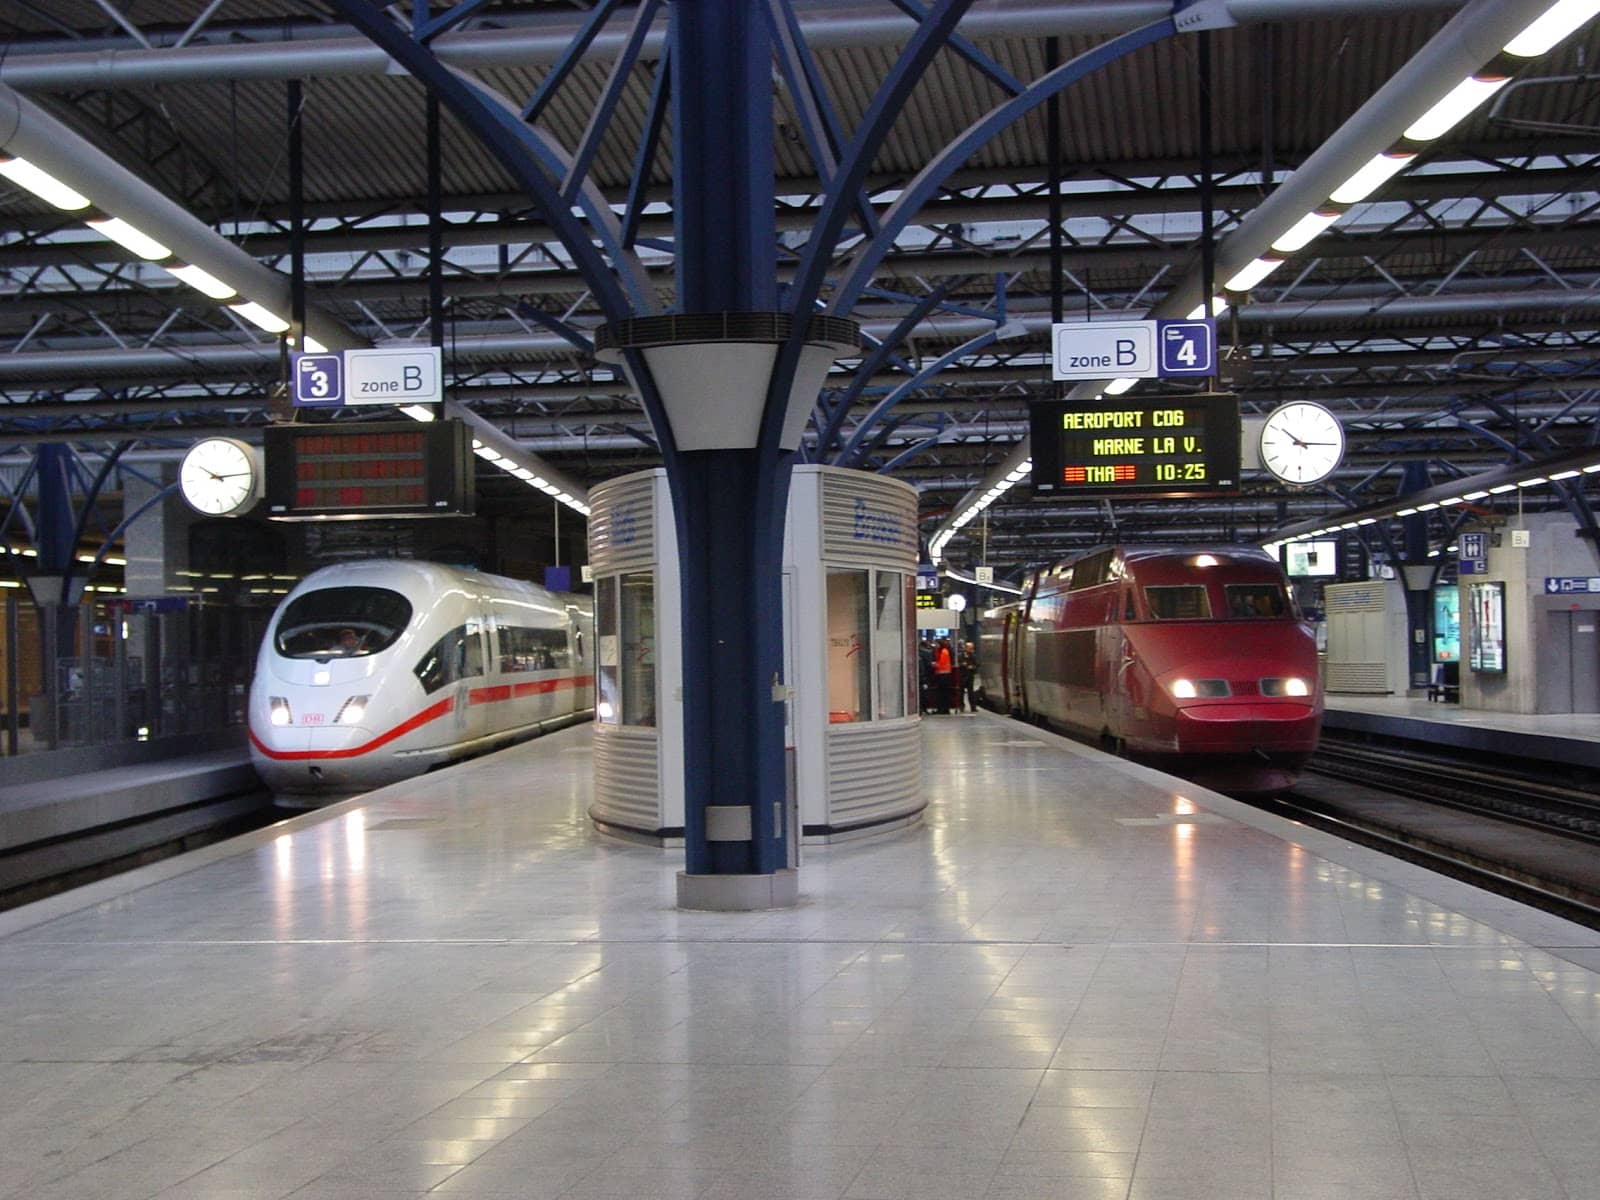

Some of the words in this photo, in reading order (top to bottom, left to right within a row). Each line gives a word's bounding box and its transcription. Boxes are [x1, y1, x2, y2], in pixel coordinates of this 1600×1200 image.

[1070, 355, 1111, 368] zone
[1116, 340, 1137, 366] B
[1177, 340, 1197, 366] 4
[310, 371, 329, 397] 3
[360, 381, 399, 392] zone
[403, 366, 423, 391] B
[1063, 411, 1144, 429] AEROPORT
[1093, 438, 1144, 455] MARNE
[1153, 437, 1174, 453] LA
[1183, 436, 1203, 453] V.
[1085, 465, 1115, 482] THA
[1155, 463, 1206, 481] 10:25
